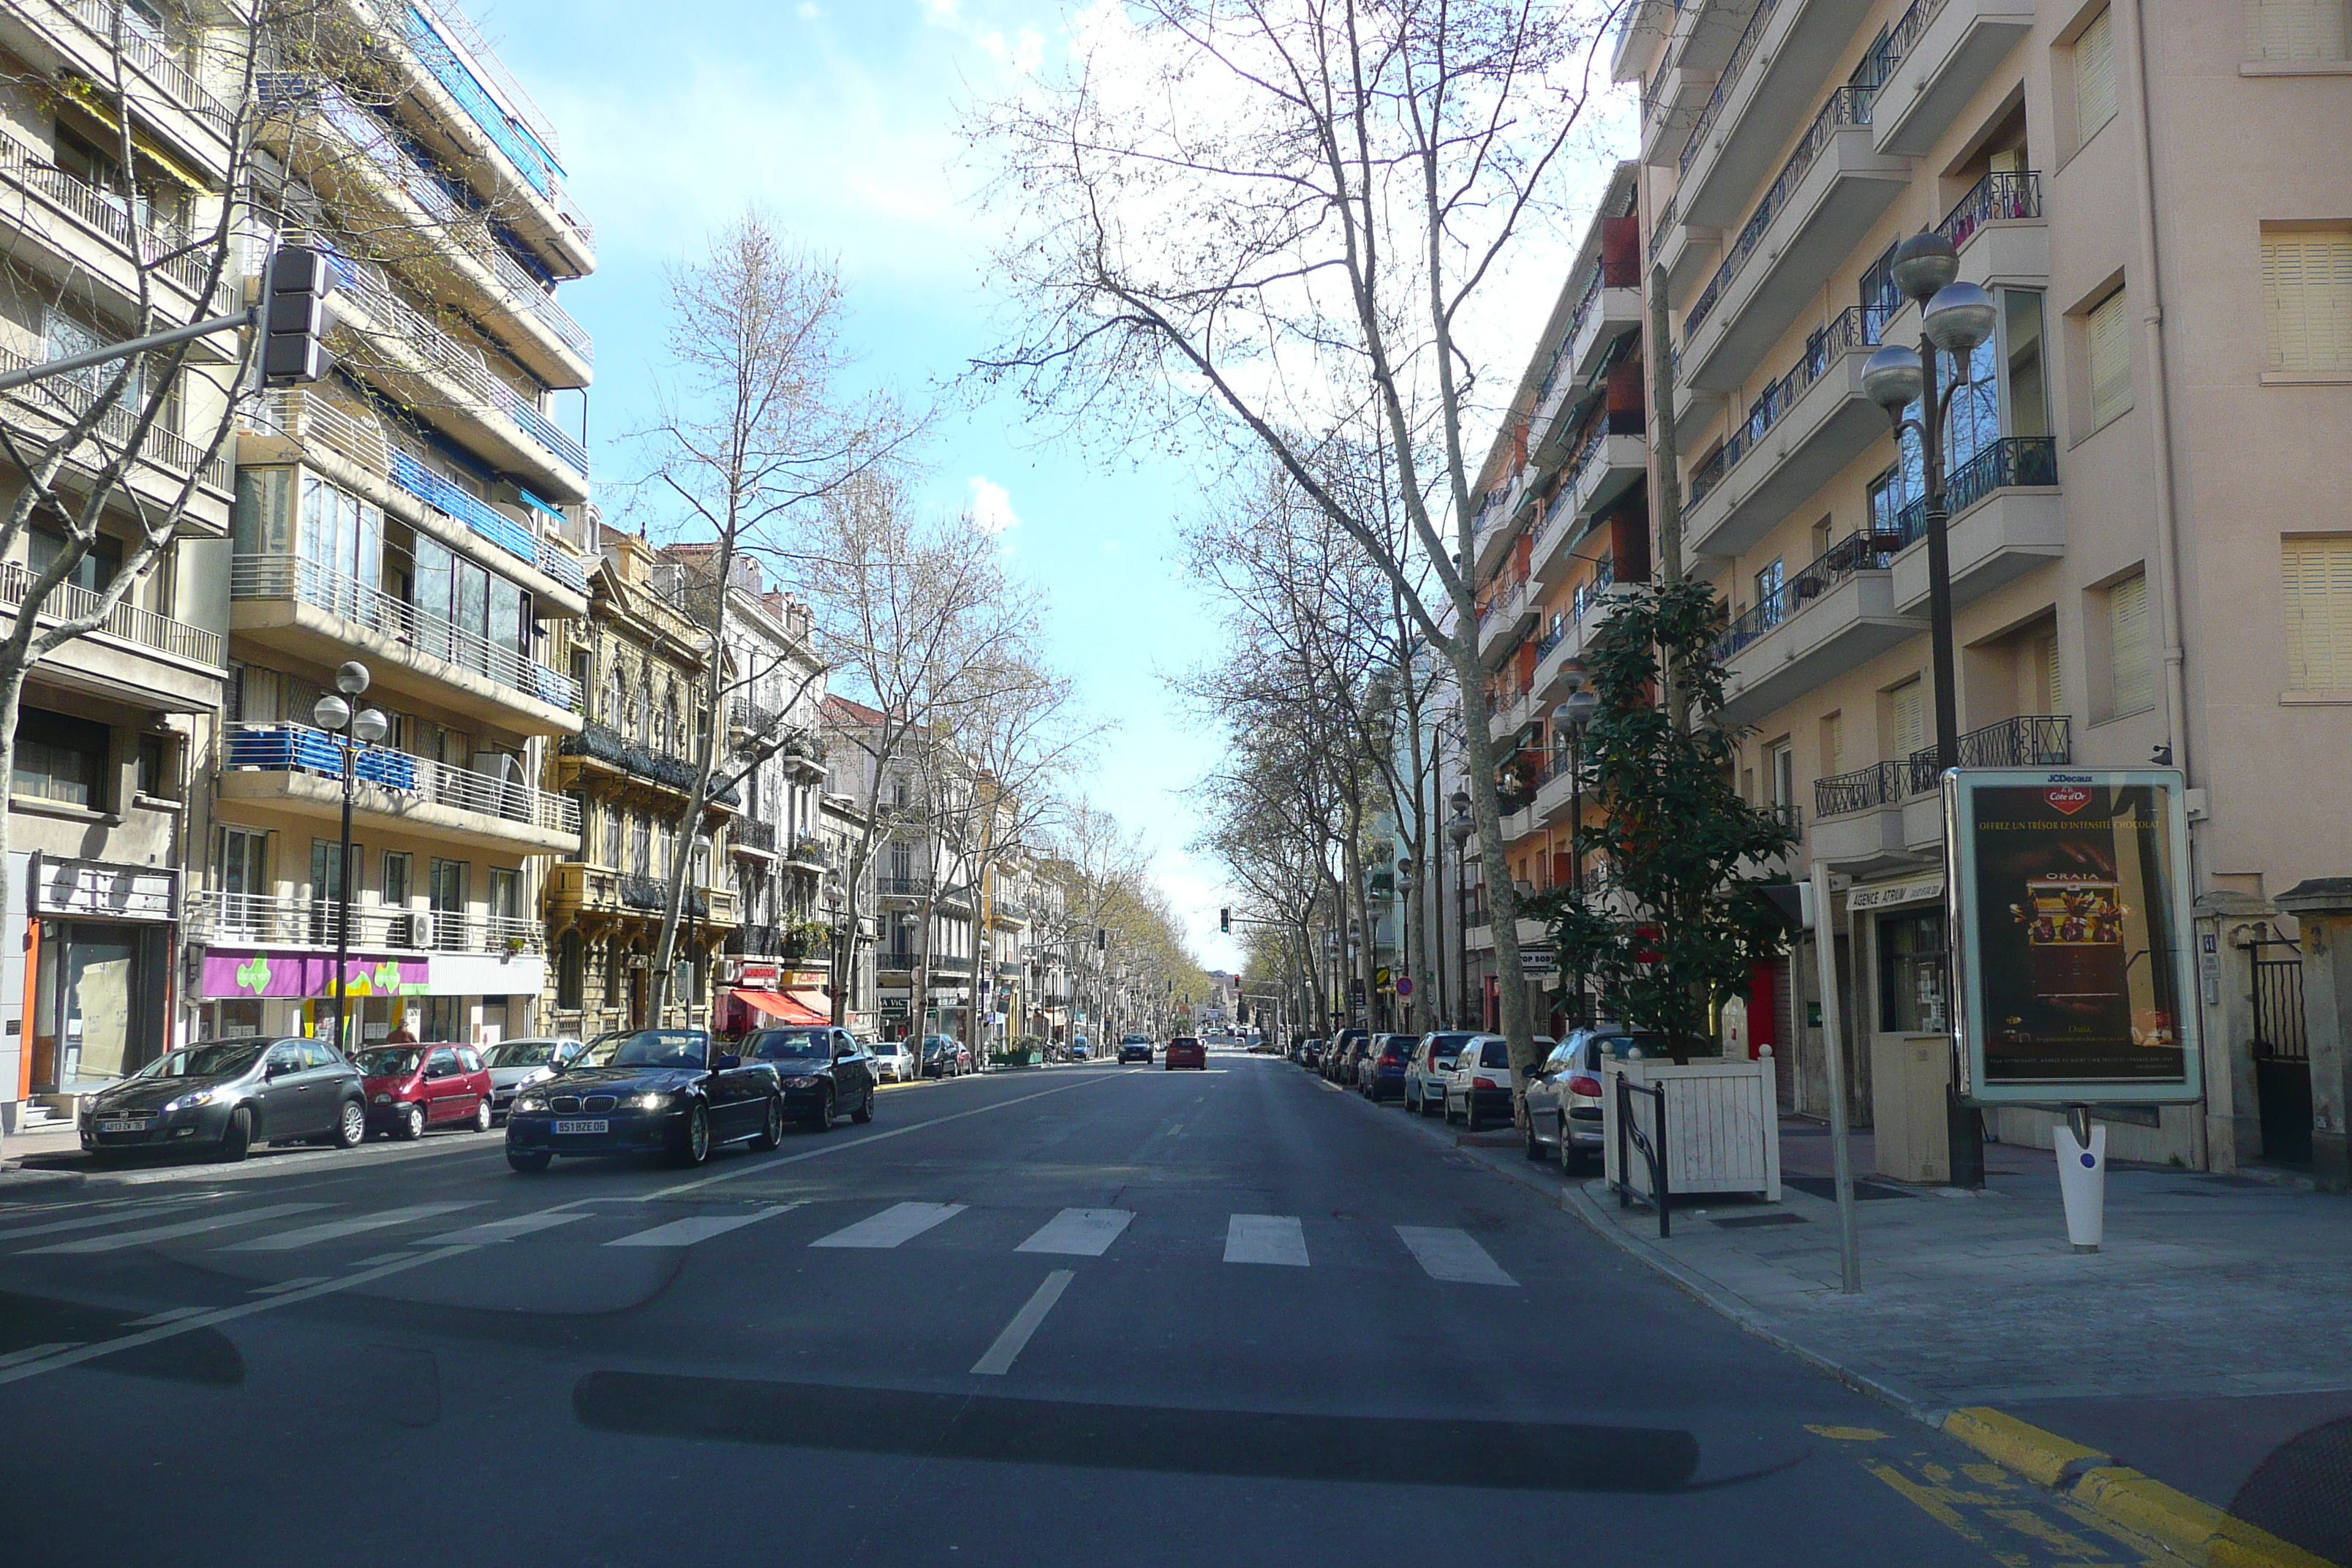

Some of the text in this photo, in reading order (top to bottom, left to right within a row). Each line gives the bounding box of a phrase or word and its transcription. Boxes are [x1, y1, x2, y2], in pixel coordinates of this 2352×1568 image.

[2048, 774, 2092, 783] JCDecaux
[2050, 792, 2085, 800] Côte d'Or
[1979, 819, 2159, 830] OFFREZ UN TRÉSOR D'INTENSITÉ CHOCOLAT
[1852, 892, 1880, 906] AGENCE
[1882, 886, 1907, 903] ATRIUM
[1535, 955, 1555, 963] BODY
